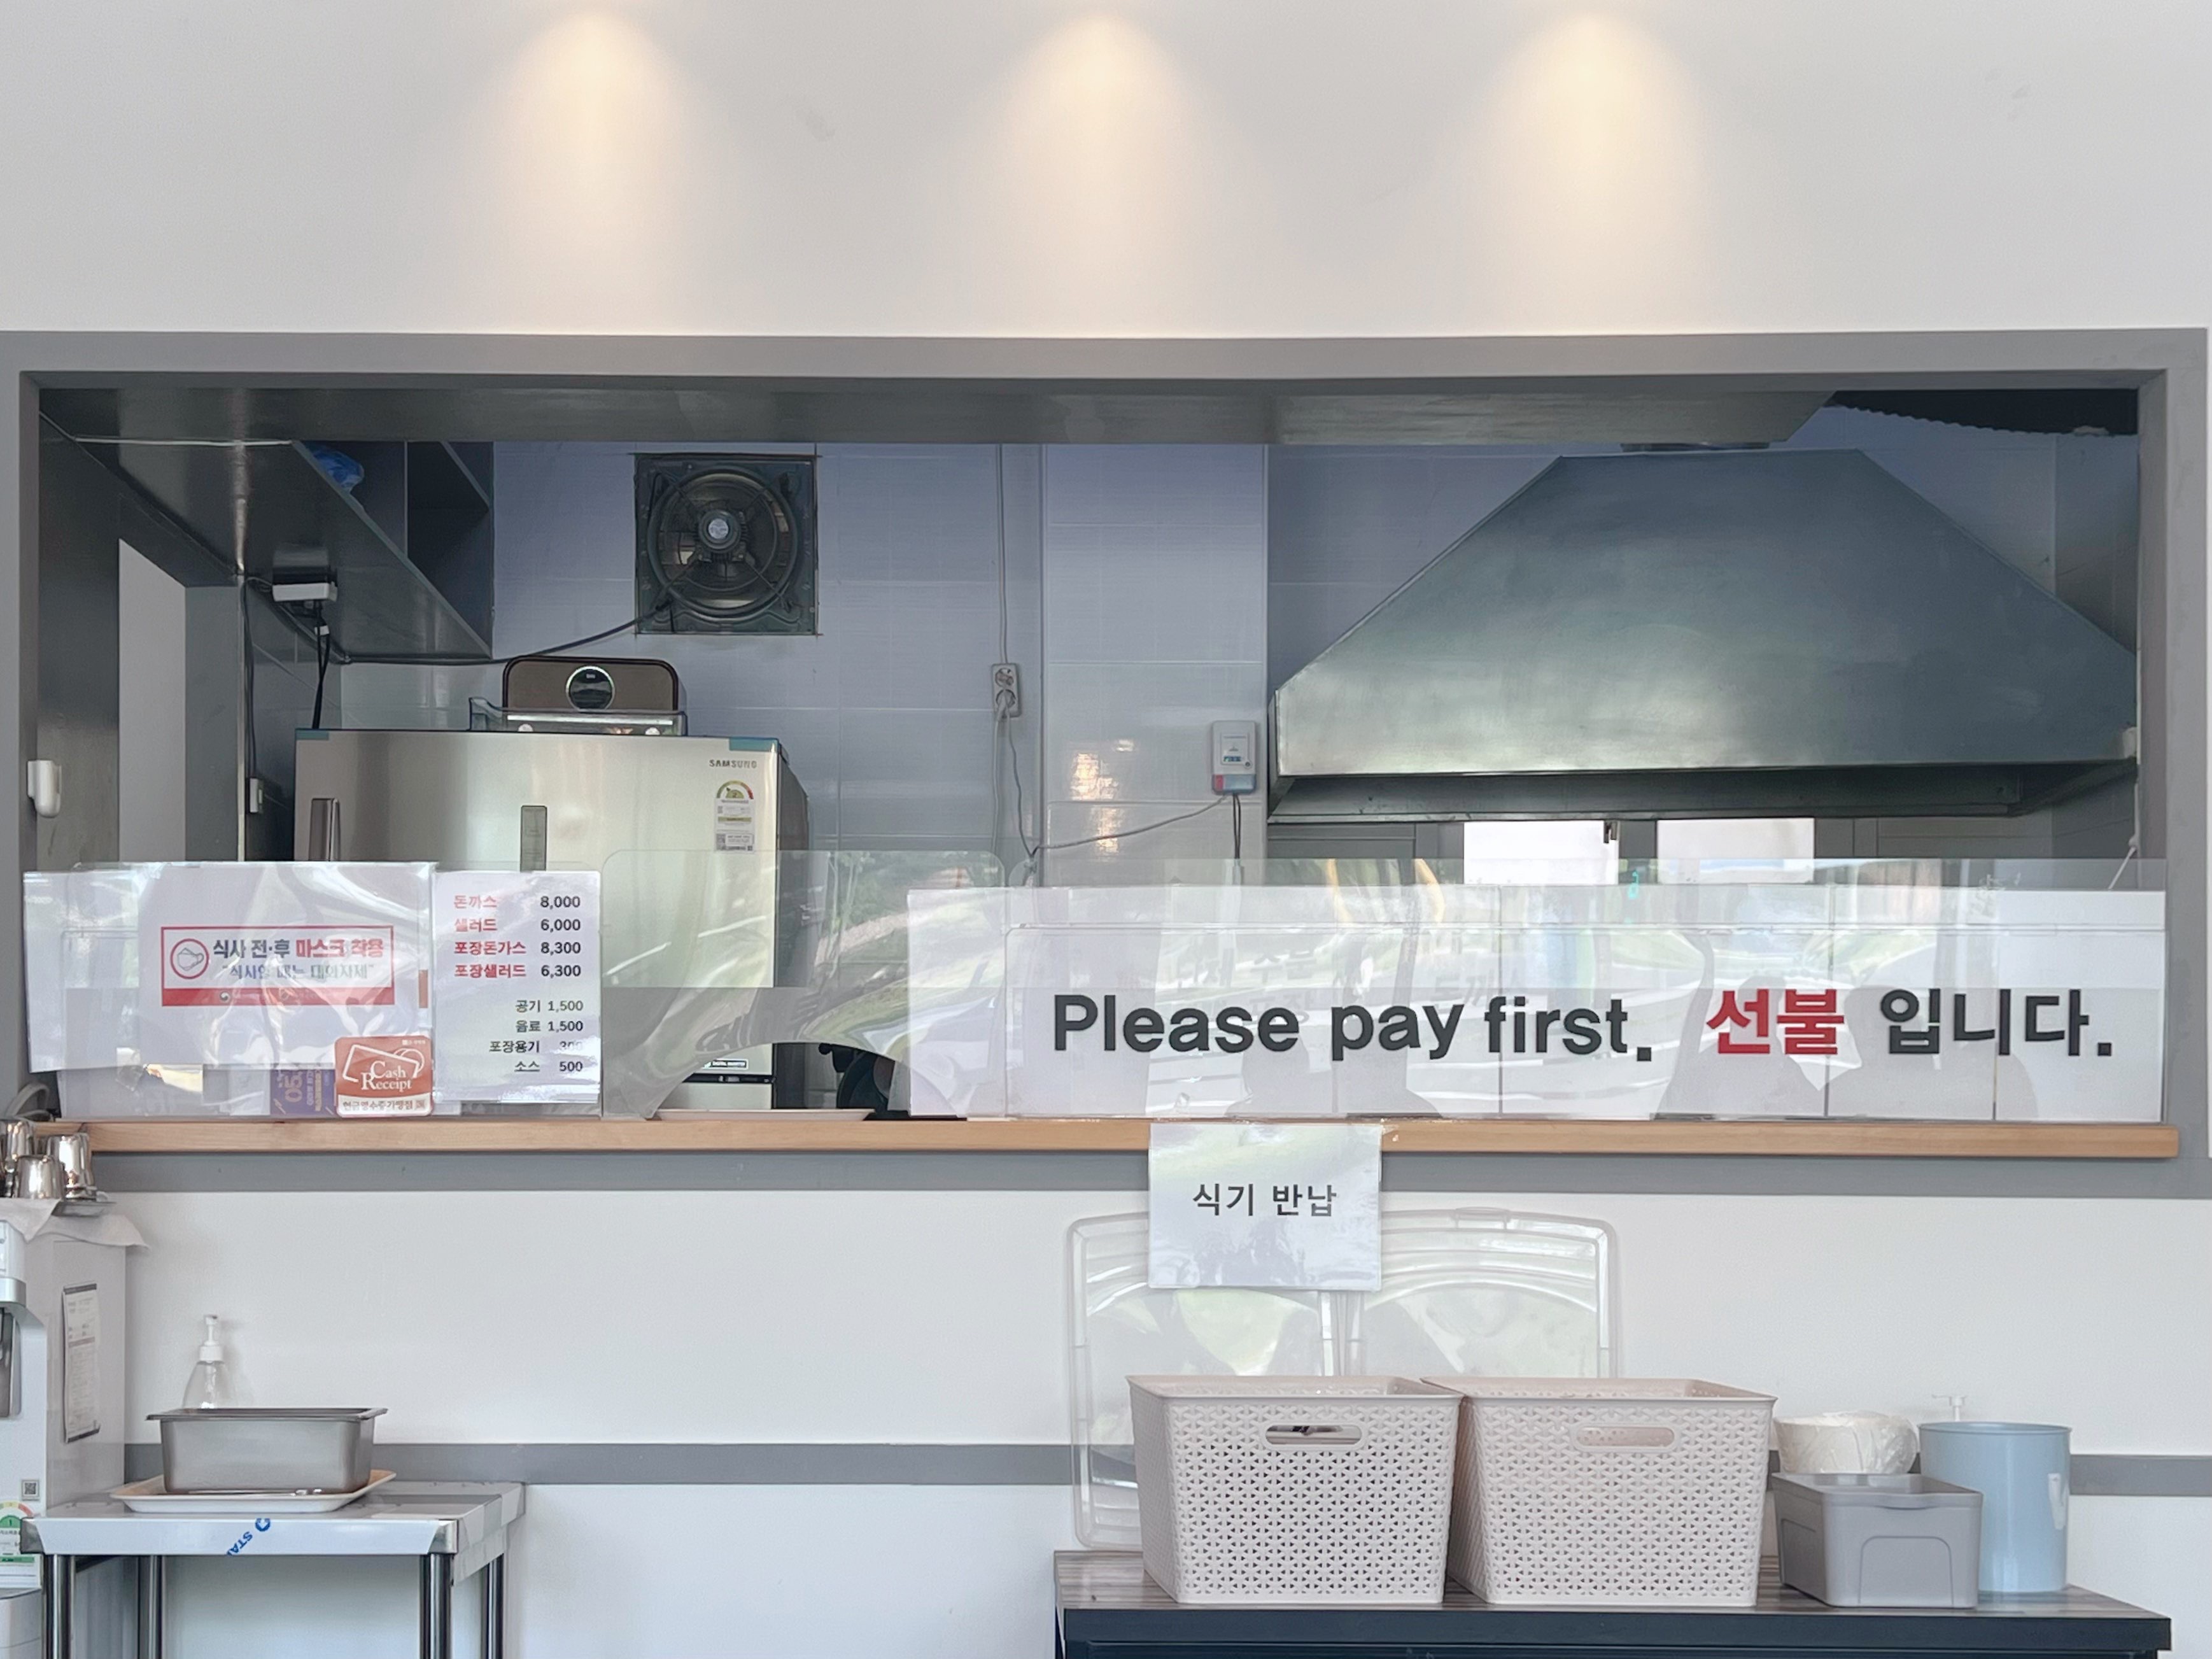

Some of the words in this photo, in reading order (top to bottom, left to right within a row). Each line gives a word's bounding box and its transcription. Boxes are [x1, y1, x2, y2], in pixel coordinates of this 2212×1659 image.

[709, 759, 757, 769] SAMSUNG
[454, 895, 498, 909] 돈까스
[540, 896, 581, 910] 8,000
[540, 919, 581, 933] 6,000
[213, 938, 247, 959] 식사
[296, 938, 346, 958] 마스크
[351, 938, 384, 958] 착용
[454, 941, 527, 956] 포장돈가스
[540, 942, 581, 956] 8,300
[540, 964, 582, 978] 6,300
[515, 999, 541, 1013] 공기
[547, 1000, 584, 1013] 1,500
[516, 1020, 542, 1033] 음료
[547, 1020, 584, 1033] 1,500
[1053, 994, 1300, 1054] Please
[1331, 1001, 1464, 1062] pay
[1484, 994, 1652, 1062] first.
[1706, 987, 1845, 1056] 선불
[1879, 987, 2113, 1058] 입니다.
[489, 1040, 540, 1054] 포장용기
[369, 1061, 406, 1079] Cash
[514, 1061, 540, 1073] 소스
[559, 1061, 583, 1073] 500
[361, 1072, 412, 1092] Receipt
[1192, 1183, 1255, 1217] 식기
[1272, 1183, 1337, 1217] 반납
